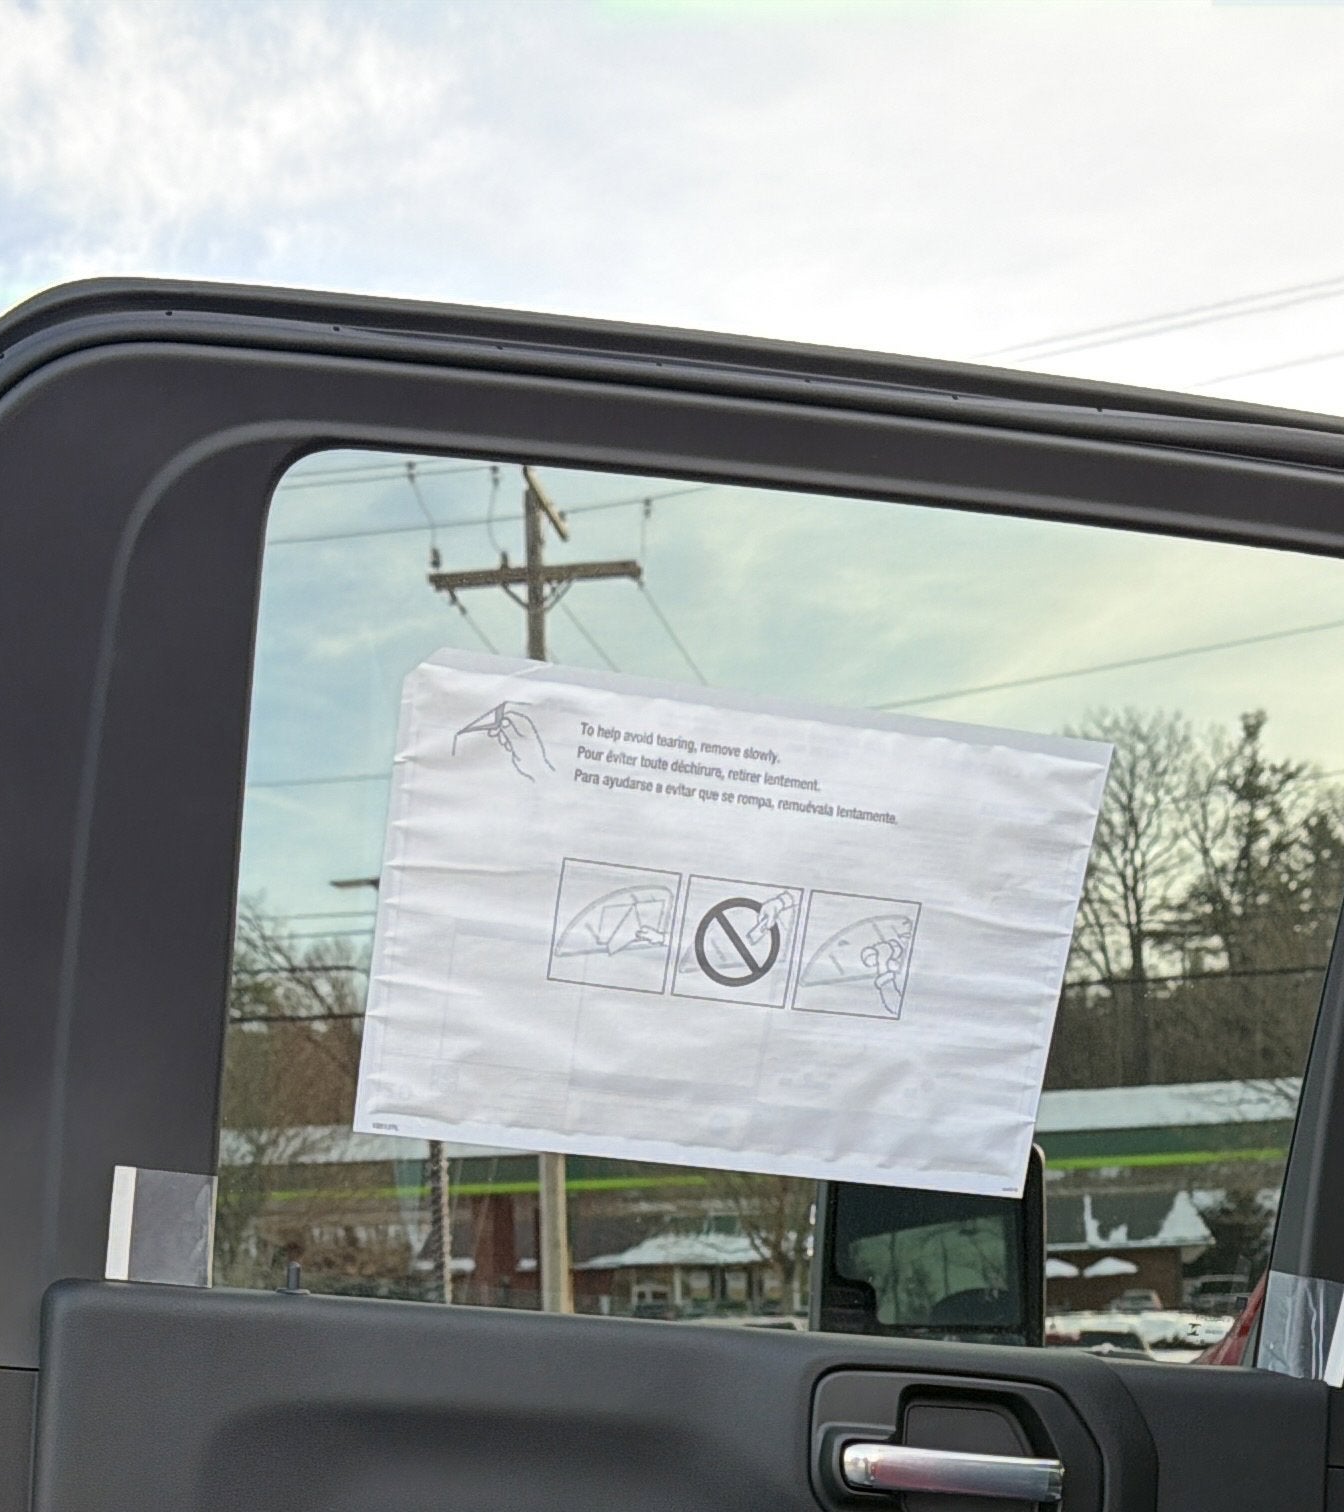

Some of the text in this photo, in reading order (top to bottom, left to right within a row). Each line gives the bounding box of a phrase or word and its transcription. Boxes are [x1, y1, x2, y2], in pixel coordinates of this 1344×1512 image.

[581, 721, 780, 765] To help avoid tearing, remove slowly.
[577, 745, 821, 792] Pour éviter toute déchirure, retirer lentement.
[574, 769, 599, 785] Para
[602, 775, 653, 792] ayudarse
[656, 783, 663, 793] a
[665, 784, 696, 797] evitar
[699, 788, 719, 803] que
[721, 791, 735, 804] se
[737, 793, 775, 810] rompa,
[836, 805, 899, 825] lentamente.
